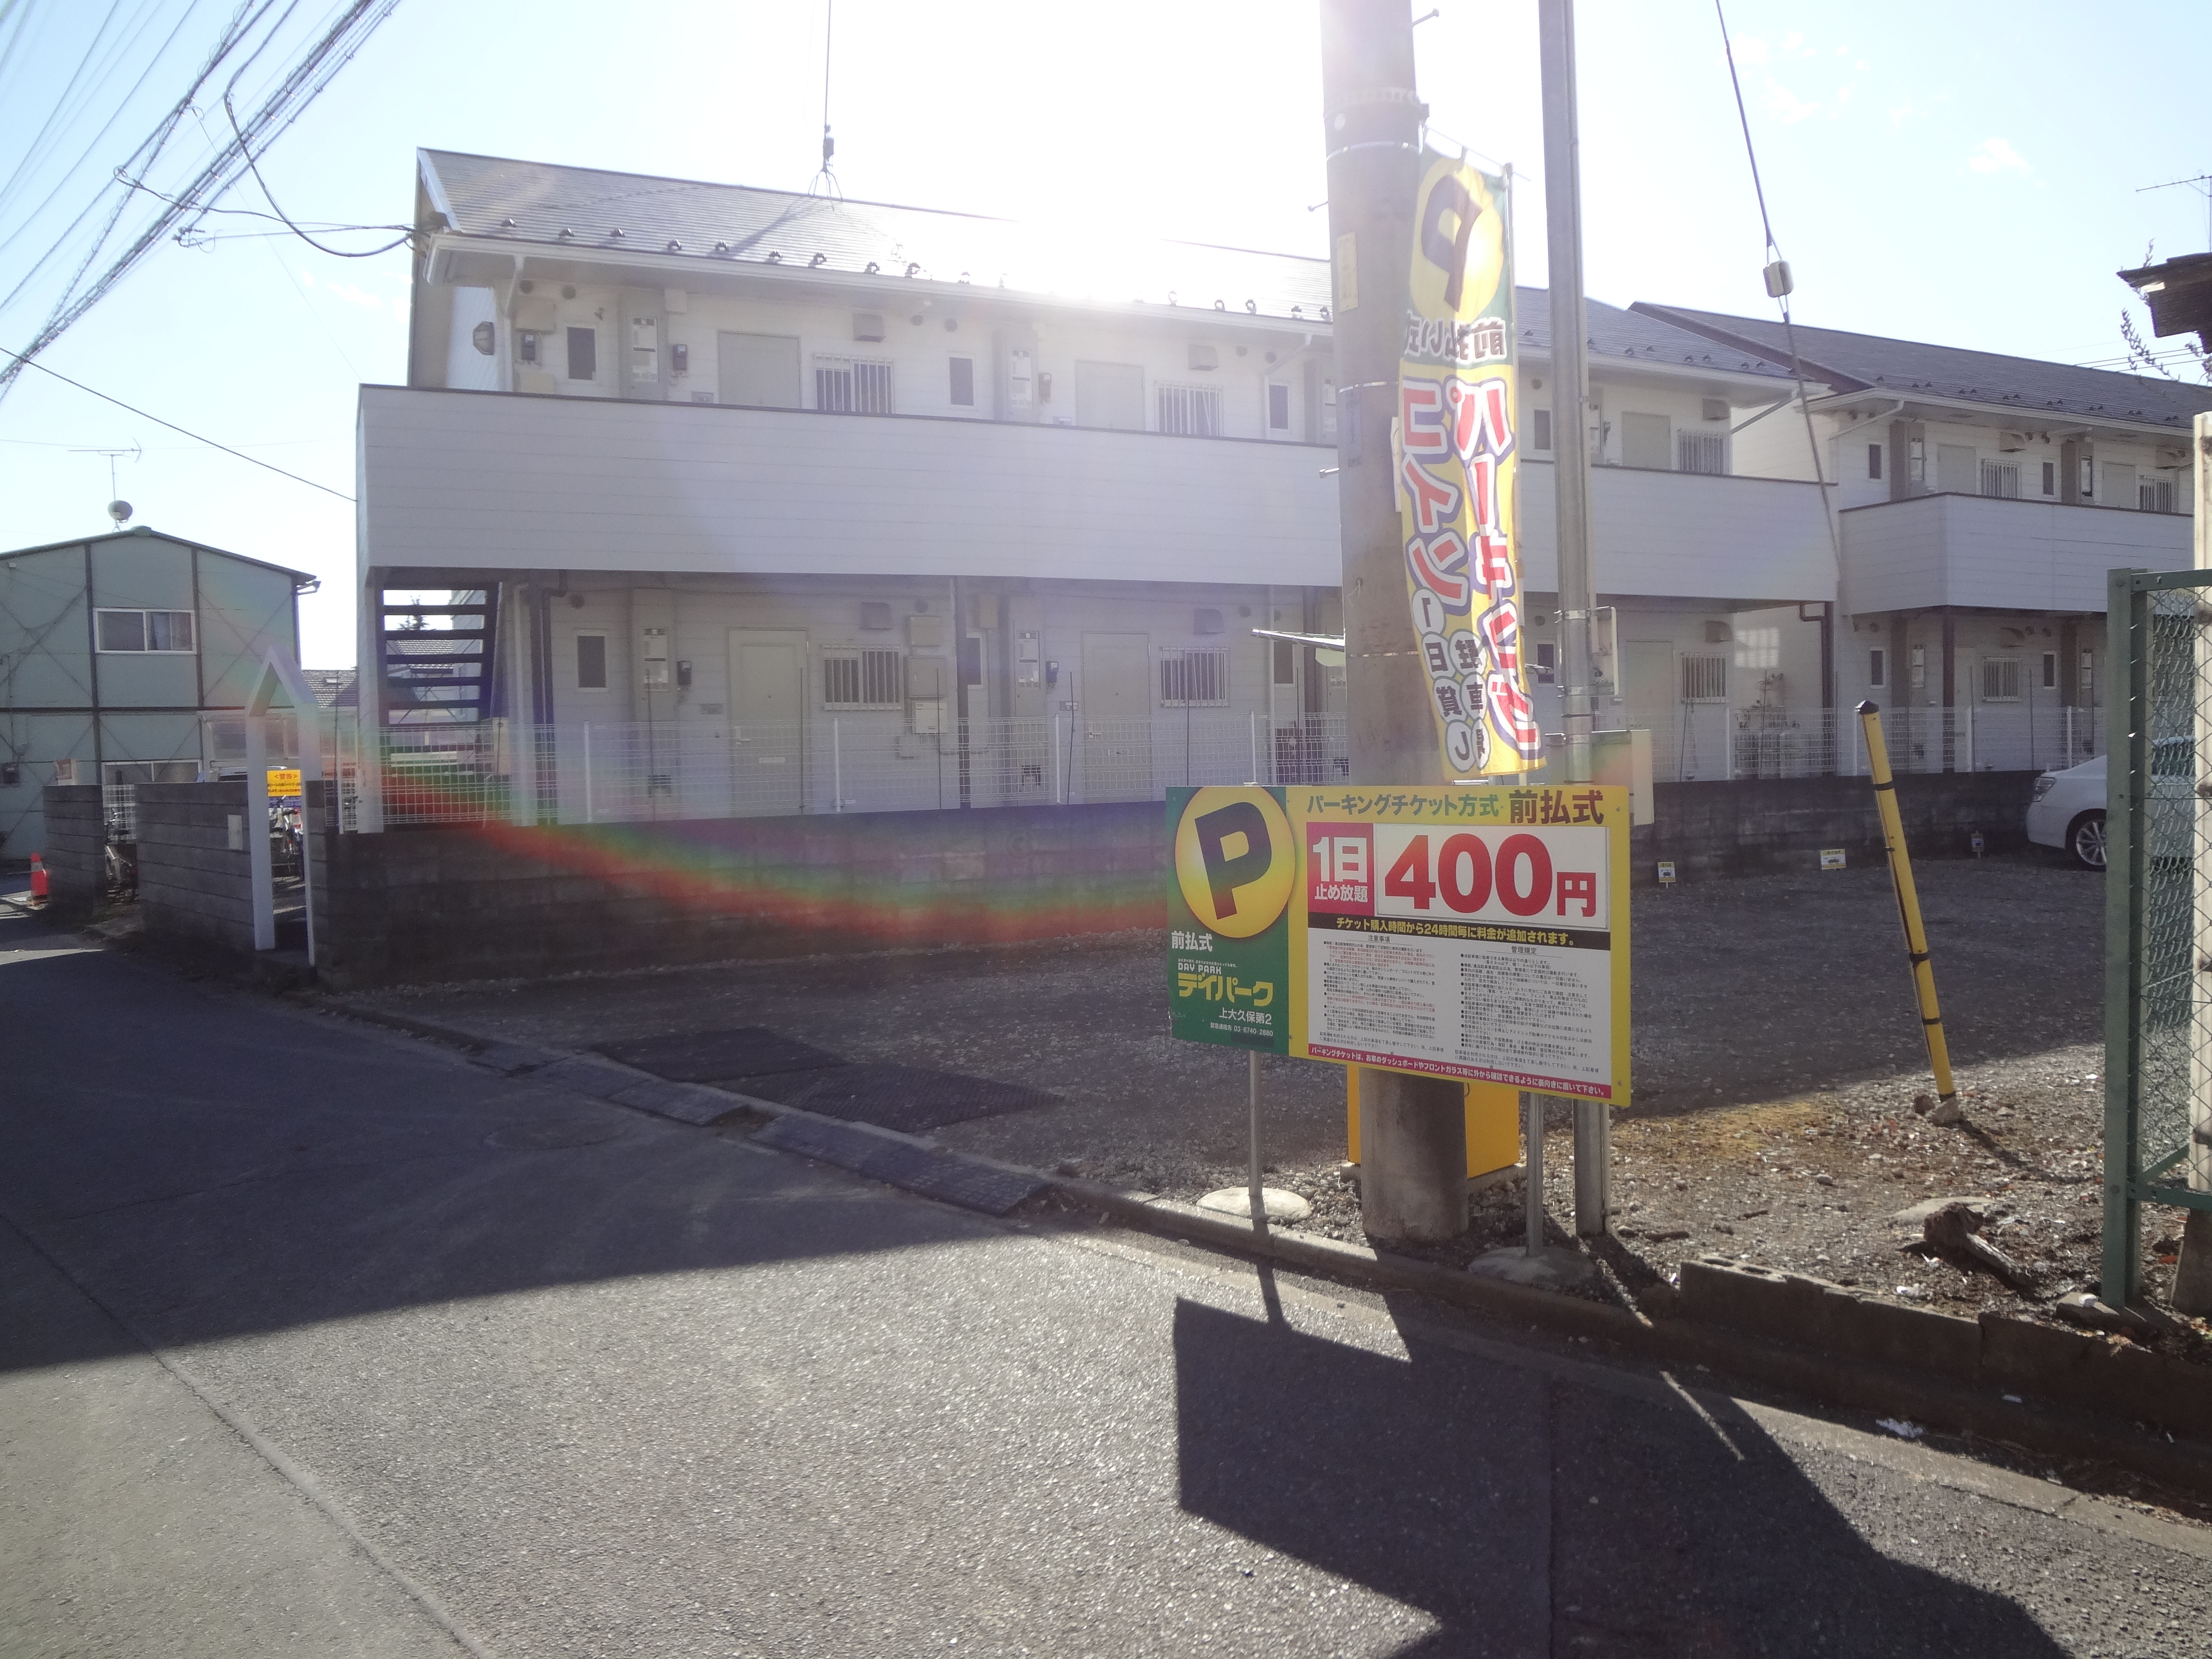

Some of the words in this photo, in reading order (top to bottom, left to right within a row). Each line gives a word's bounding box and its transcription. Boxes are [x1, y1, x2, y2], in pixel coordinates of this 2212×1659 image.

[1306, 793, 1500, 817] パーキングチケット方式
[1509, 789, 1604, 825] 前払式
[1194, 802, 1272, 920] P
[1312, 835, 1368, 882] 1日
[1384, 833, 1597, 917] 400円
[1314, 882, 1368, 903] 止め放題
[1171, 931, 1213, 952] 前払式
[1336, 917, 1576, 946] チケット購入時間から24時間毎に料金が追加されます。
[1511, 946, 1537, 954] 管理規定
[1178, 962, 1195, 972] DAY
[1198, 964, 1222, 975] PARK
[1178, 971, 1274, 1007] デイパーク
[1219, 1007, 1272, 1026] 上大久保第2
